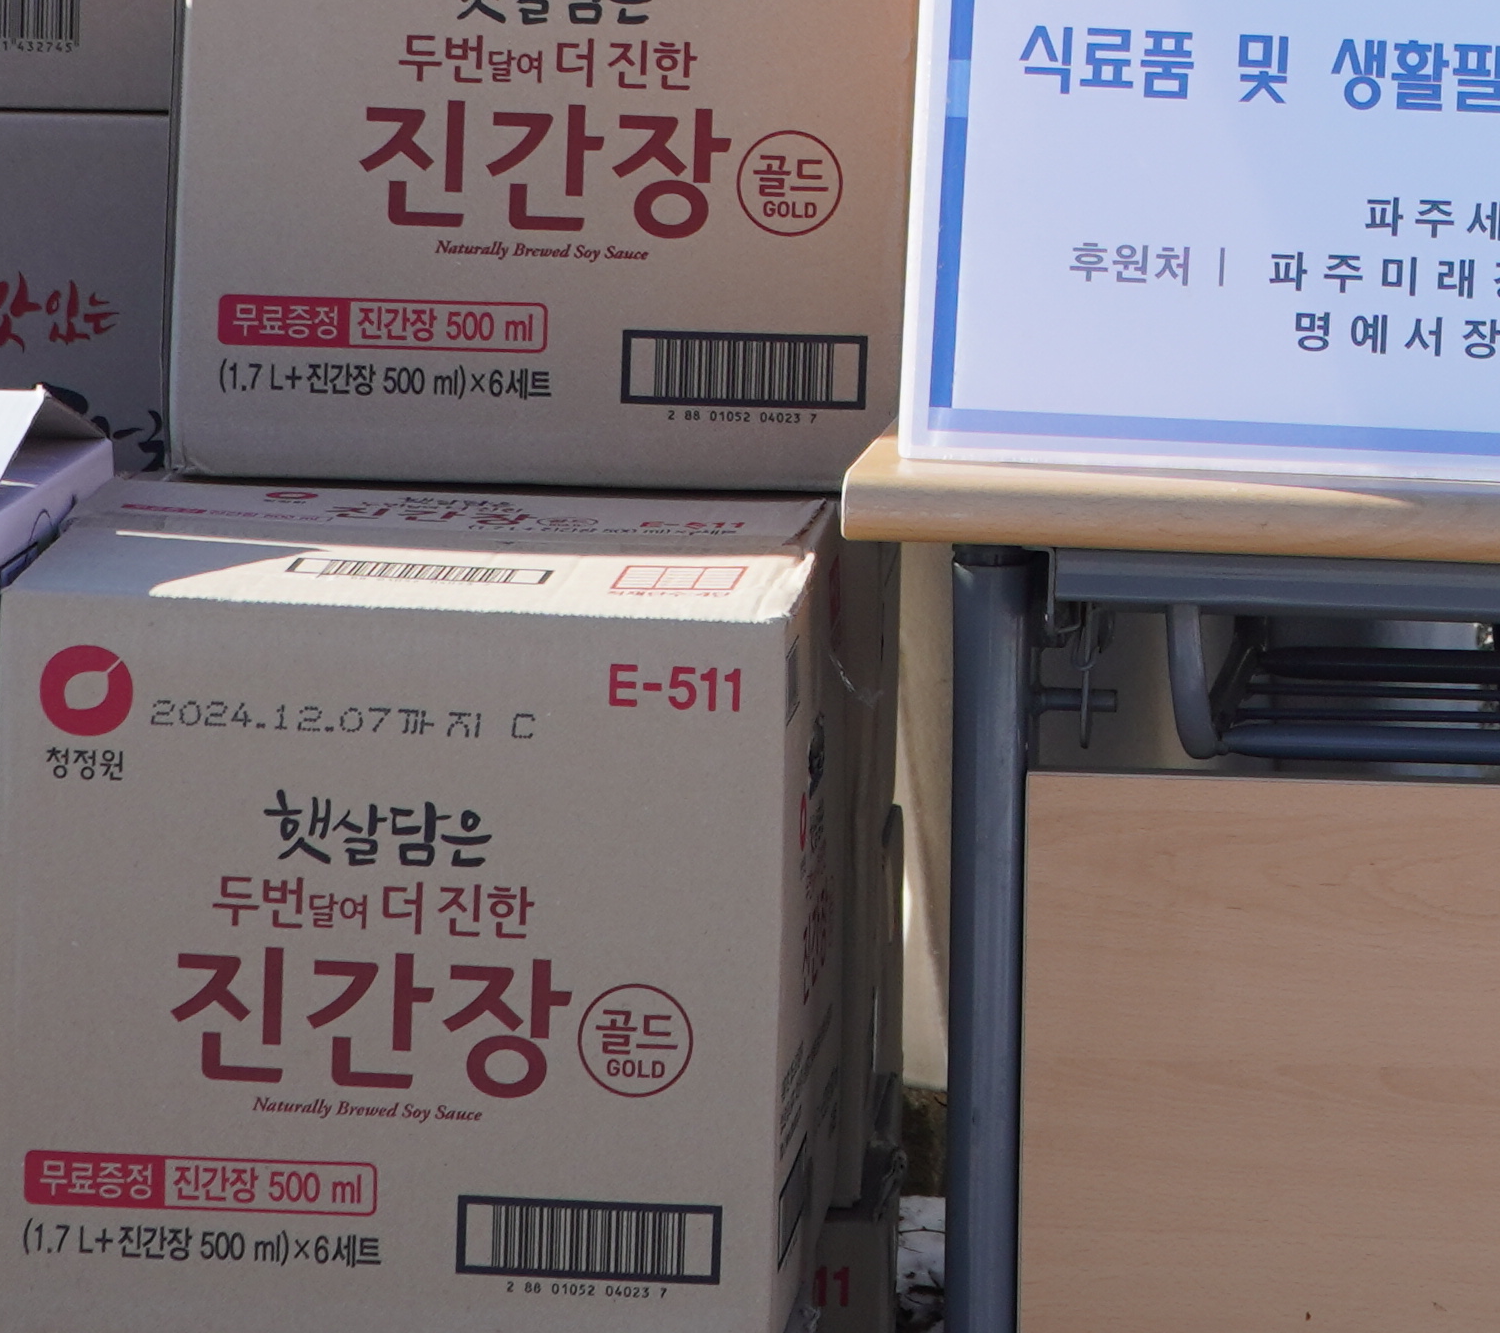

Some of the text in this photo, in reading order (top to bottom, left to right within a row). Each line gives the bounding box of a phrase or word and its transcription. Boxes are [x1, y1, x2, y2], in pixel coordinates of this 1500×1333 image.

[17, 41, 73, 53] 432745
[606, 41, 698, 91] 진한
[1019, 25, 1195, 99] 식료품
[1237, 33, 1289, 105] 및
[360, 99, 733, 239] 진간장
[752, 155, 829, 197] 골드
[762, 200, 818, 220] GOLD
[435, 240, 649, 263] Naturally Brewed Soy Sauce
[1068, 241, 1191, 286] 후원처
[232, 303, 495, 343] 무료증정 진간장 500
[384, 367, 425, 395] 500
[709, 411, 800, 424] 01052 04023
[608, 663, 743, 713] E-511
[45, 747, 125, 782] 청정원
[264, 789, 492, 867] 햇살담은
[437, 884, 534, 939] 진한
[169, 947, 573, 1099] 진간장
[595, 1009, 679, 1055] 골드
[606, 1059, 666, 1079] GOLD
[252, 1097, 483, 1123] Naturally Brewed Soy Sauce
[39, 1159, 321, 1205] 무료증정 진간장 500
[201, 1231, 245, 1262] 500
[551, 1283, 650, 1299] 01052 04023
